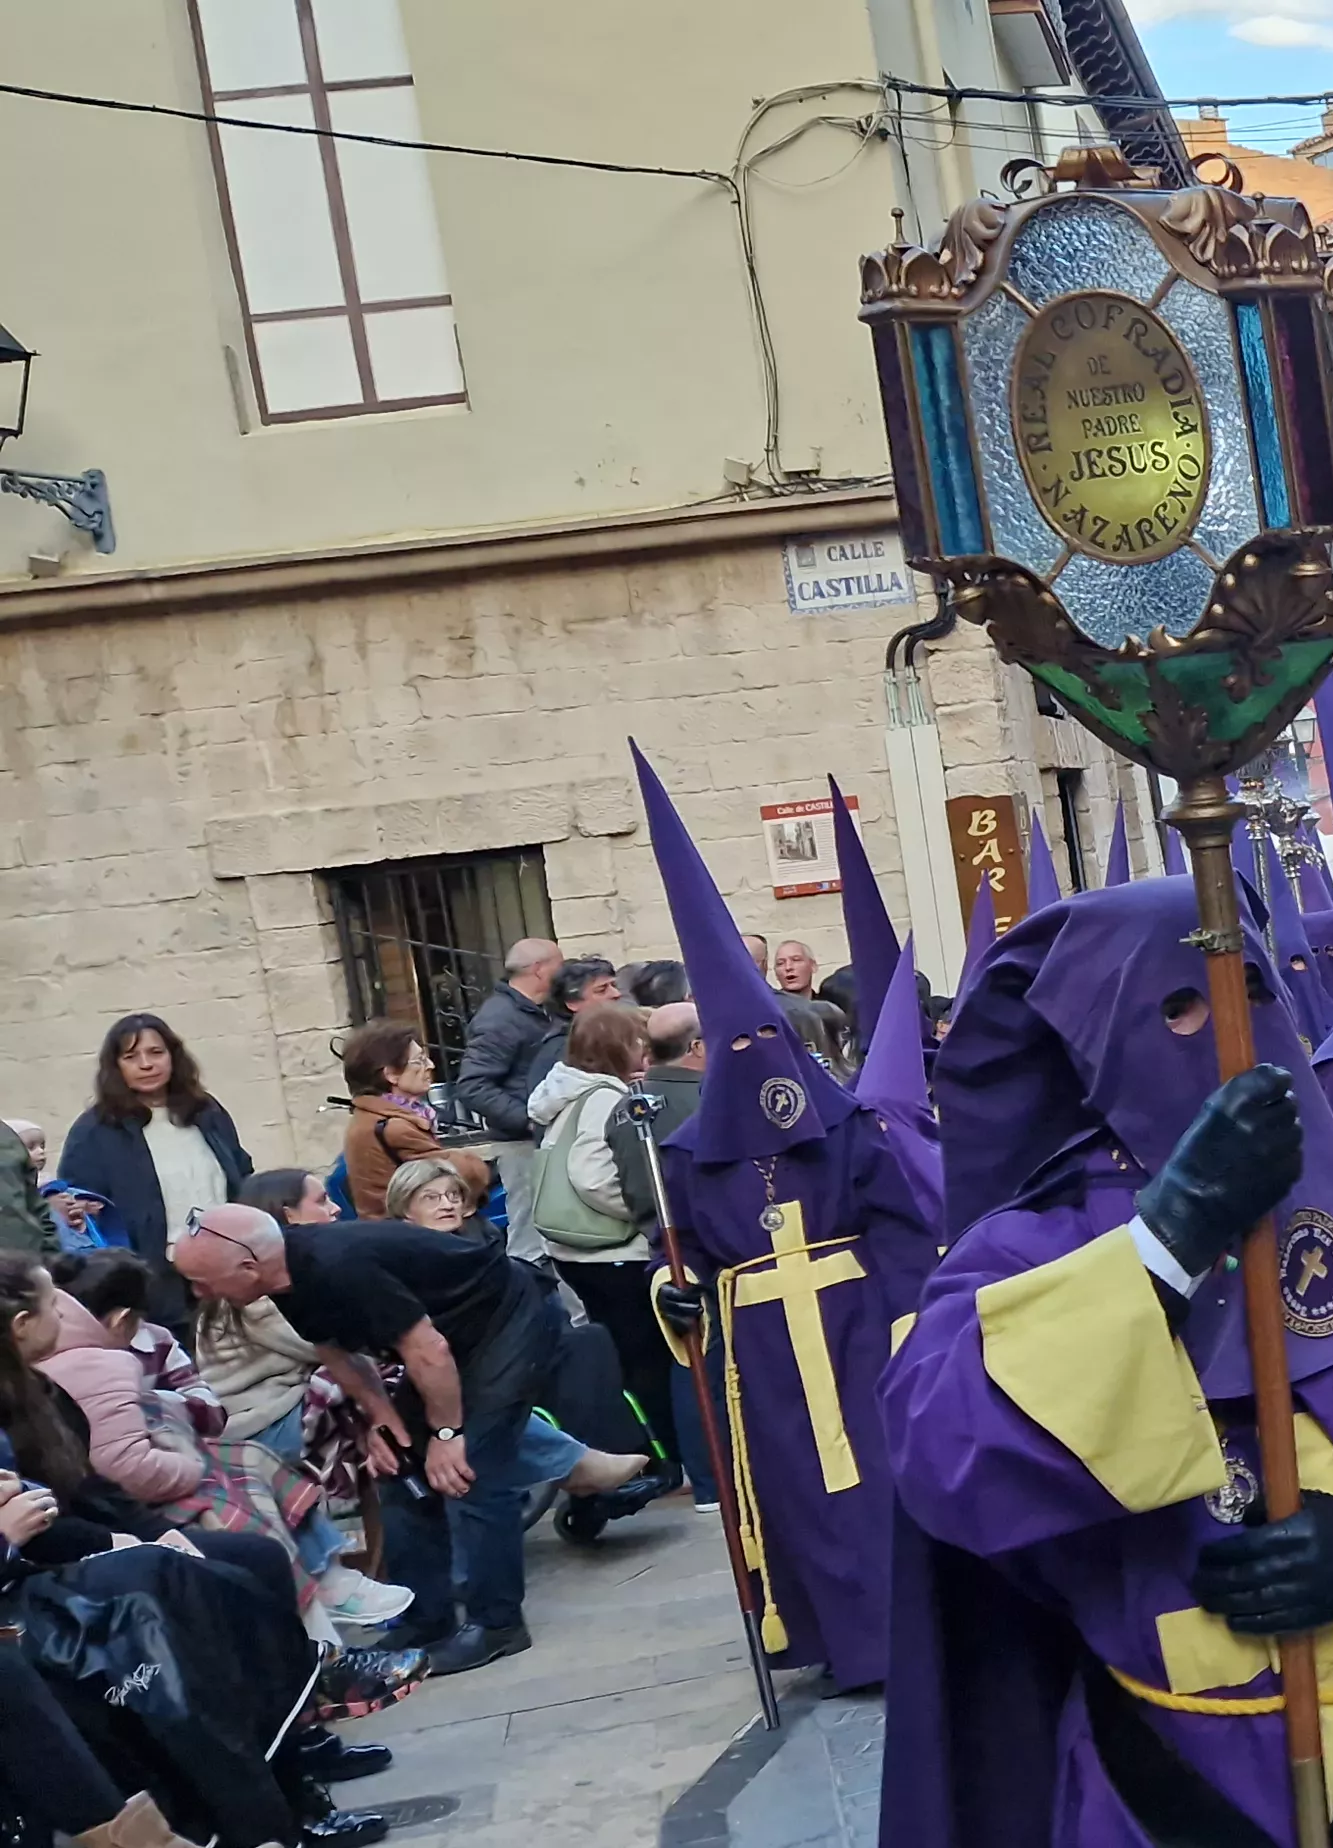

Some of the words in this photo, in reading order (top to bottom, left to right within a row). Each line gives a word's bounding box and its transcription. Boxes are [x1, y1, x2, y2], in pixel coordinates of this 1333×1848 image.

[1022, 351, 1056, 454] REAL
[1050, 300, 1199, 439] COFRADIA
[1088, 355, 1112, 376] DE
[1066, 382, 1146, 409] NUESTRO
[1081, 412, 1142, 439] PADRE
[1068, 441, 1170, 482] JESUS
[1042, 453, 1201, 552] NAZARENO
[827, 541, 885, 562] CALLE
[798, 571, 903, 601] CASTILLA
[967, 809, 1006, 893] BAR
